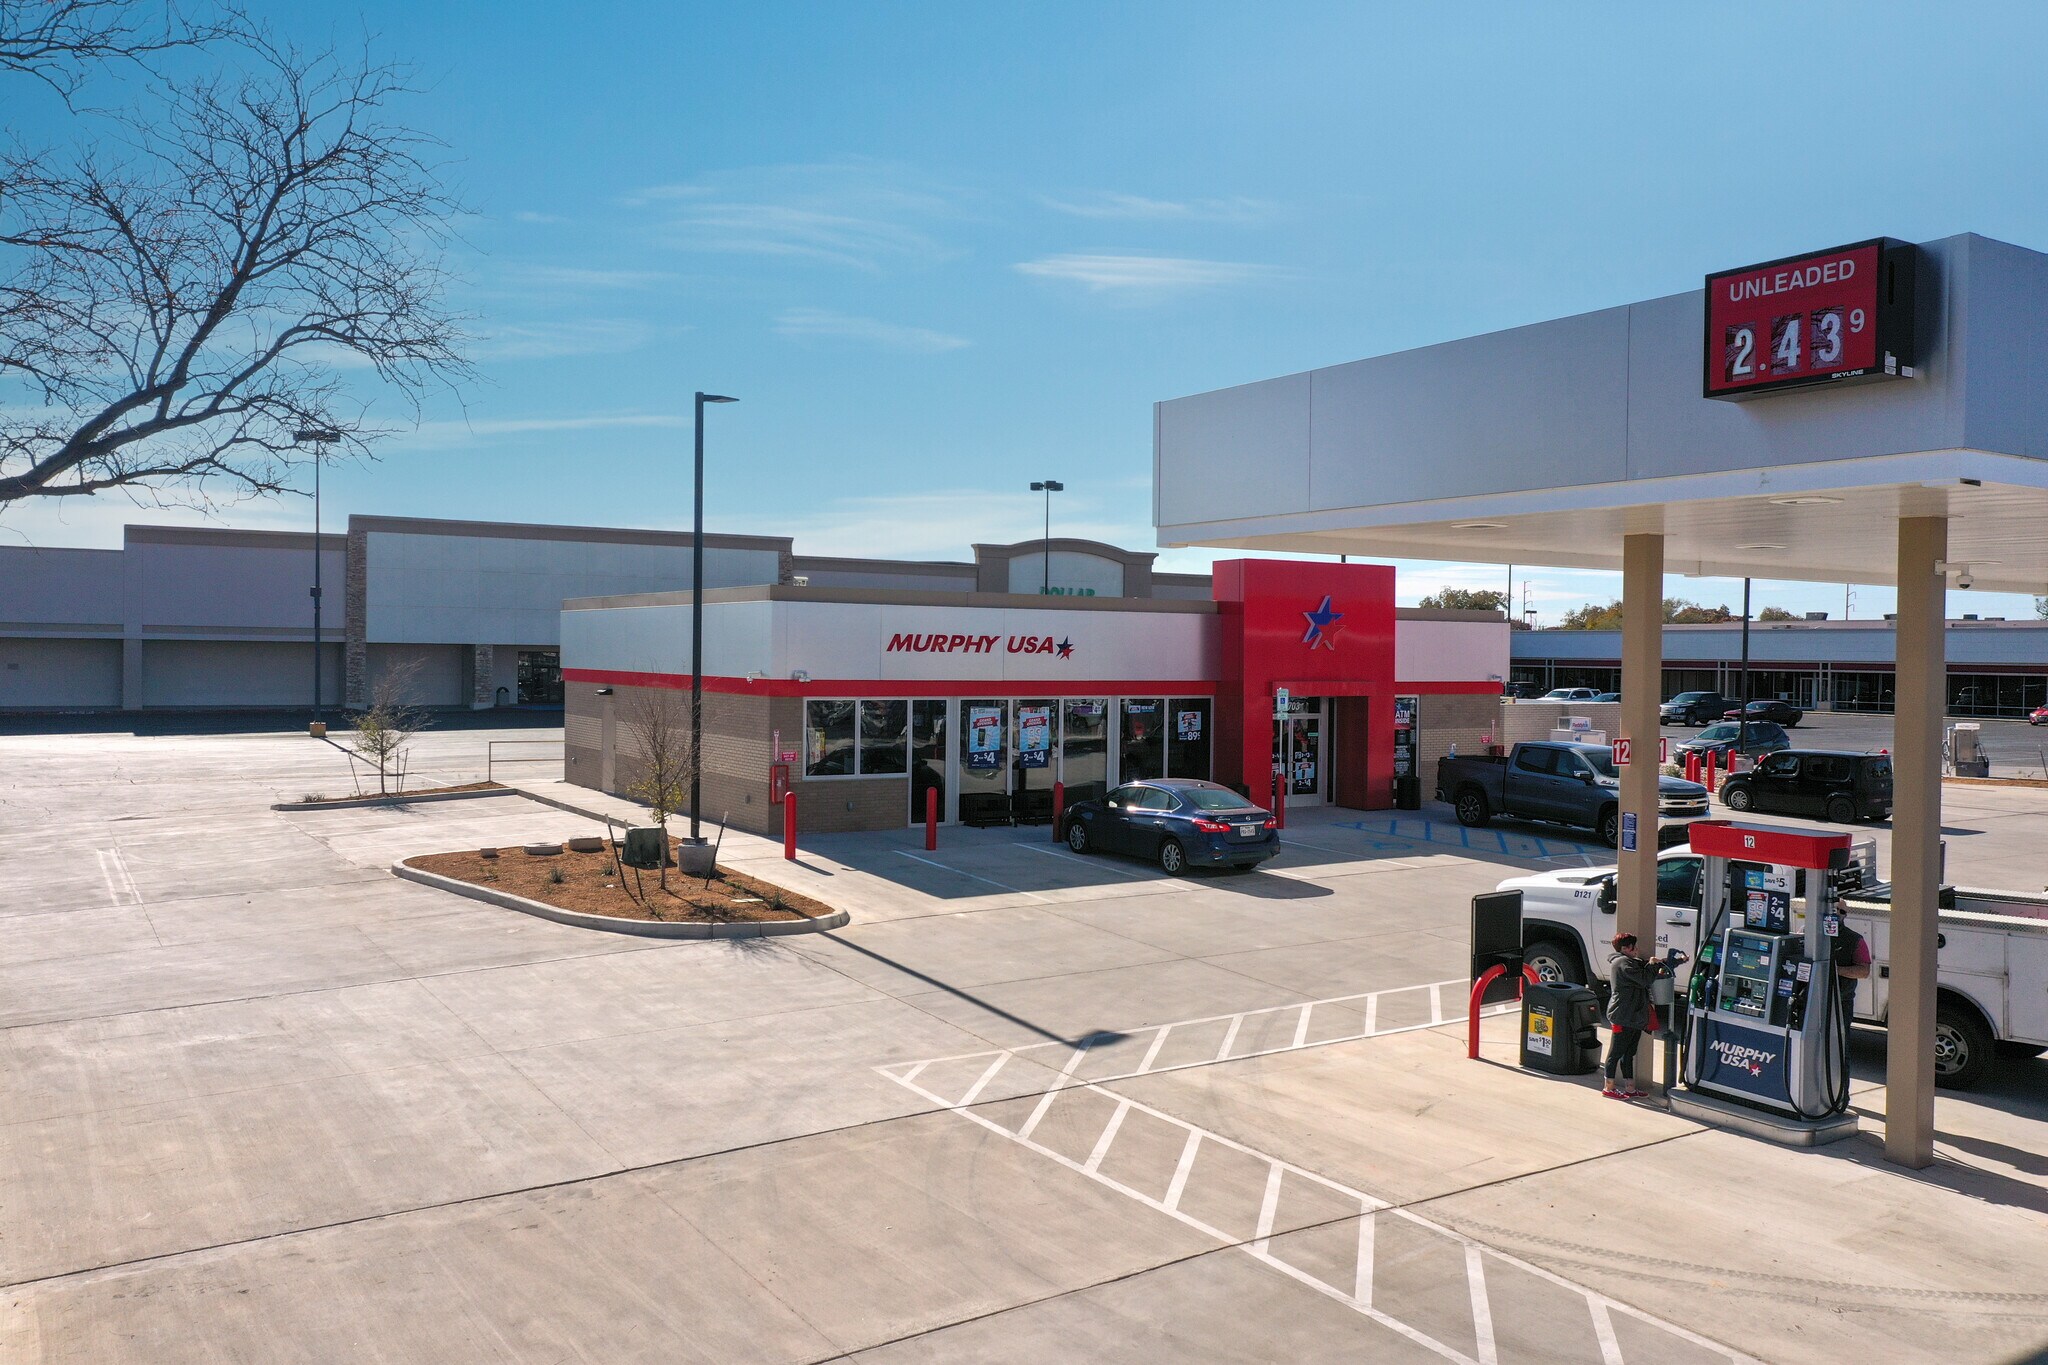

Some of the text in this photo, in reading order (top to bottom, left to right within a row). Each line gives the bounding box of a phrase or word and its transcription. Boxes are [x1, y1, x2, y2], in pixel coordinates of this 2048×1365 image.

[1729, 259, 1855, 302] UNLEADED
[1831, 369, 1864, 379] SKYLINE
[886, 633, 1054, 654] MURPHY USA
[1395, 710, 1410, 718] ATM
[1614, 741, 1630, 763] 12
[1745, 837, 1754, 847] 12
[1771, 896, 1778, 906] 2
[1770, 906, 1785, 921] $4
[1710, 1040, 1776, 1063] MURPHY
[1720, 1053, 1750, 1070] USA
